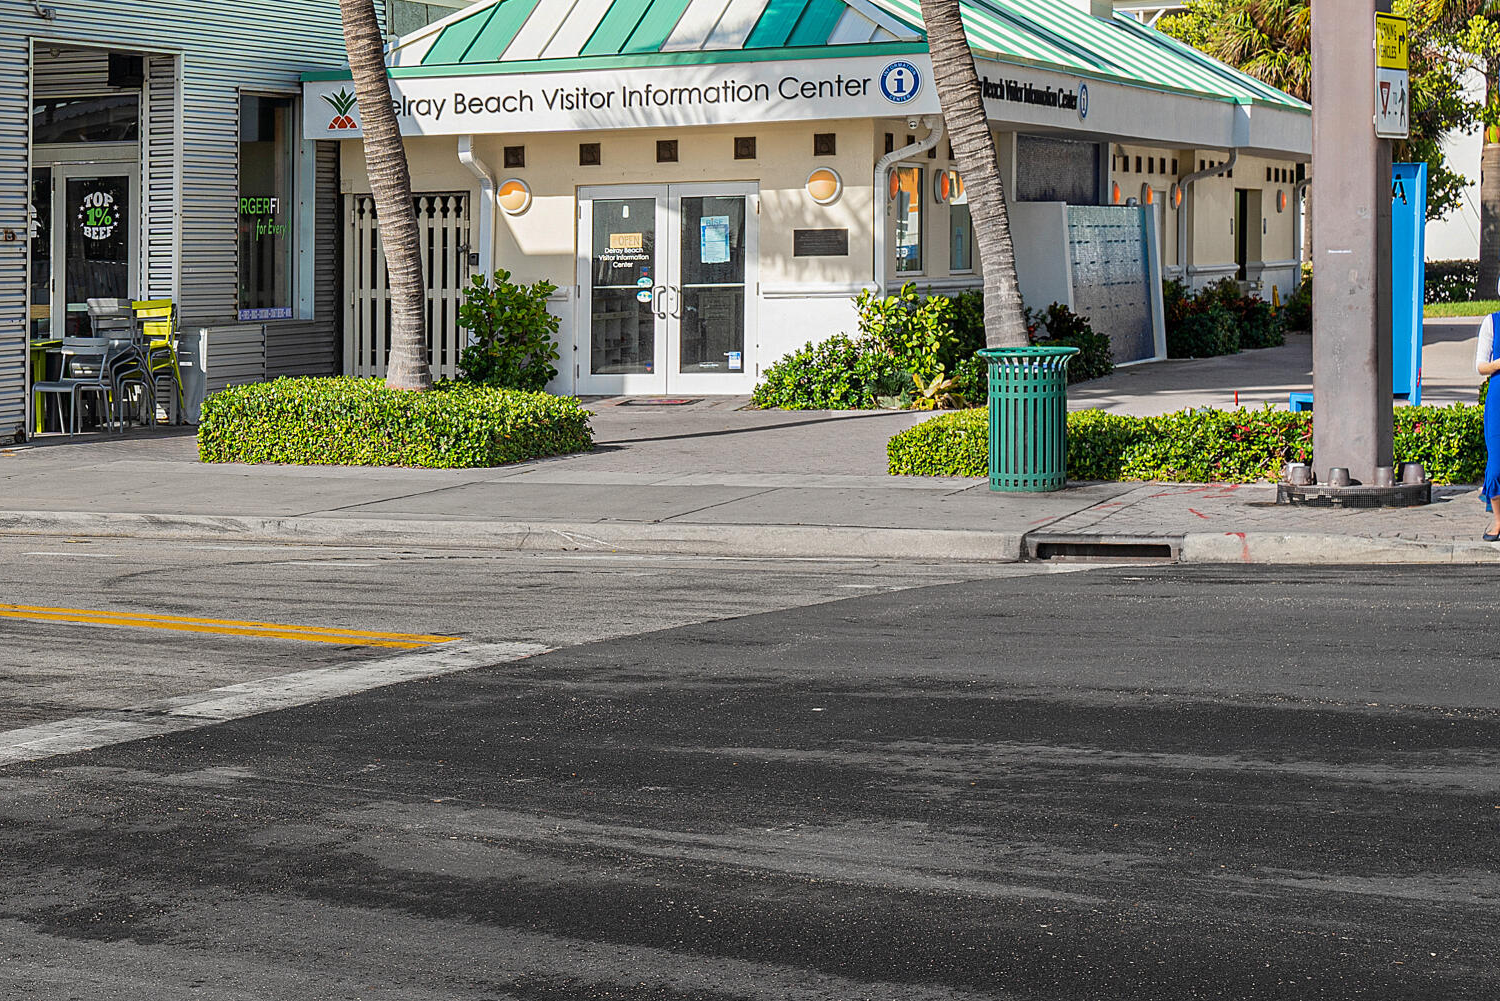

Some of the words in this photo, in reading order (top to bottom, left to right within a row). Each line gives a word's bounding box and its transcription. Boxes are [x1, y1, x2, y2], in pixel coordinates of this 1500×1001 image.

[391, 95, 446, 120] elray
[454, 89, 533, 114] Beach
[541, 86, 615, 111] Visitor
[622, 79, 769, 107] Information
[778, 74, 872, 100] Center
[83, 191, 114, 208] TOP
[240, 197, 280, 214] RGERFI
[86, 207, 112, 226] 1%
[83, 226, 114, 240] BEEF
[618, 235, 640, 246] OPEN
